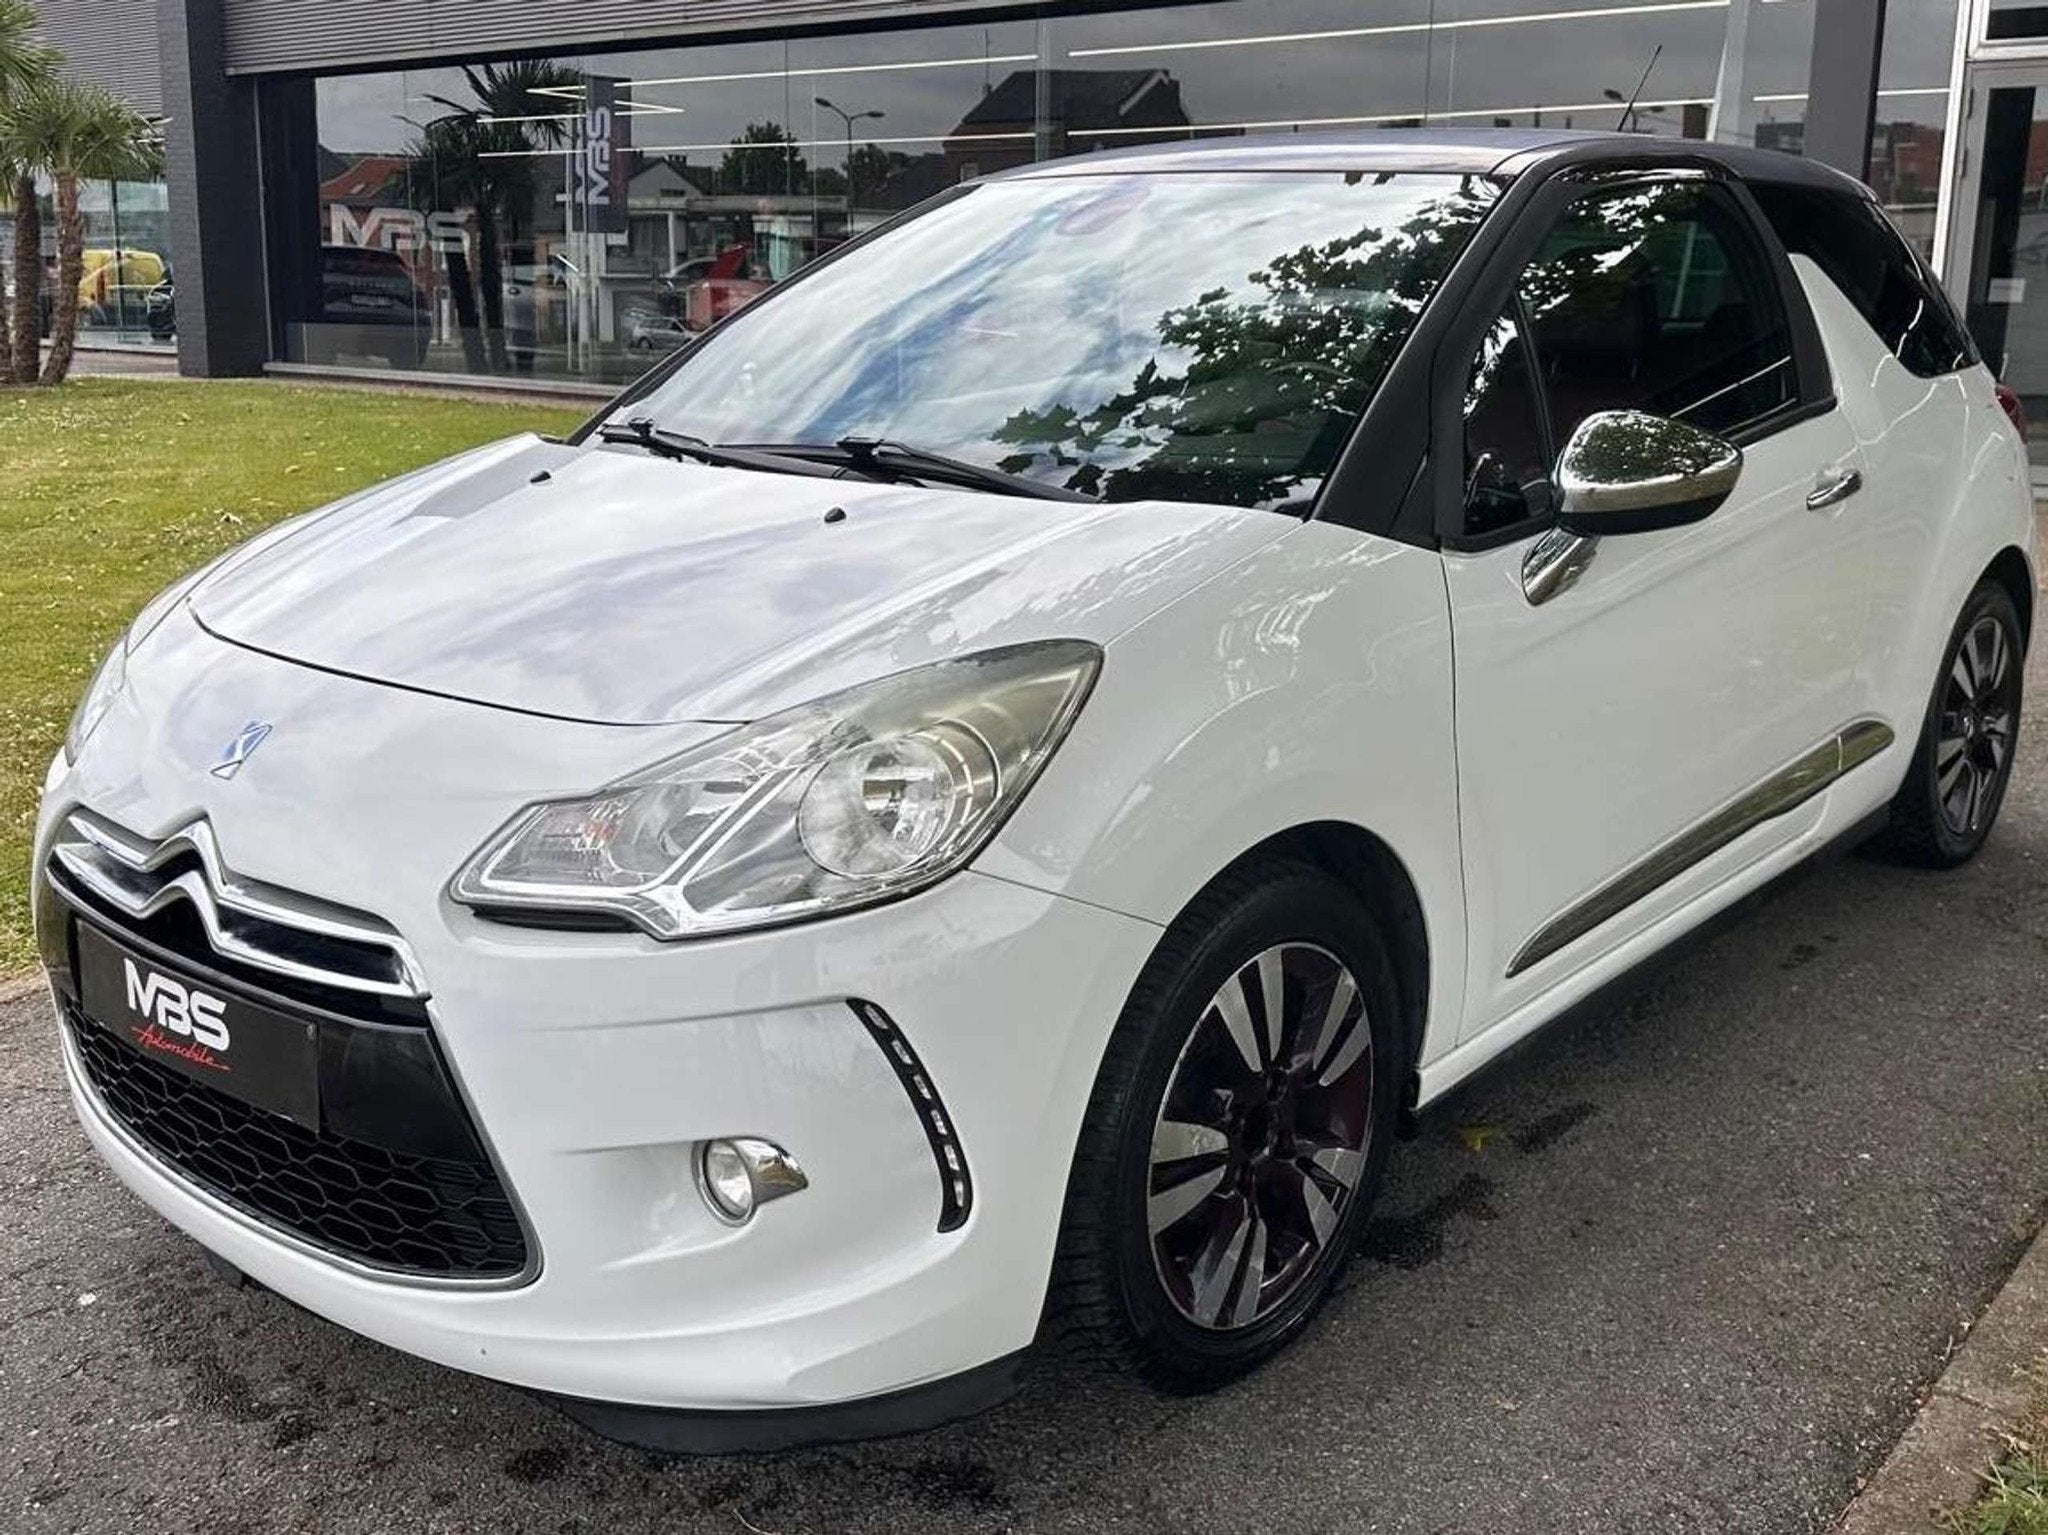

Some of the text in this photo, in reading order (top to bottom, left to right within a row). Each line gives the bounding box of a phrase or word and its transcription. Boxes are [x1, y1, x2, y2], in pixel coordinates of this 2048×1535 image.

[586, 106, 611, 205] MBS
[329, 204, 474, 253] MBS
[124, 957, 231, 1052] MBS
